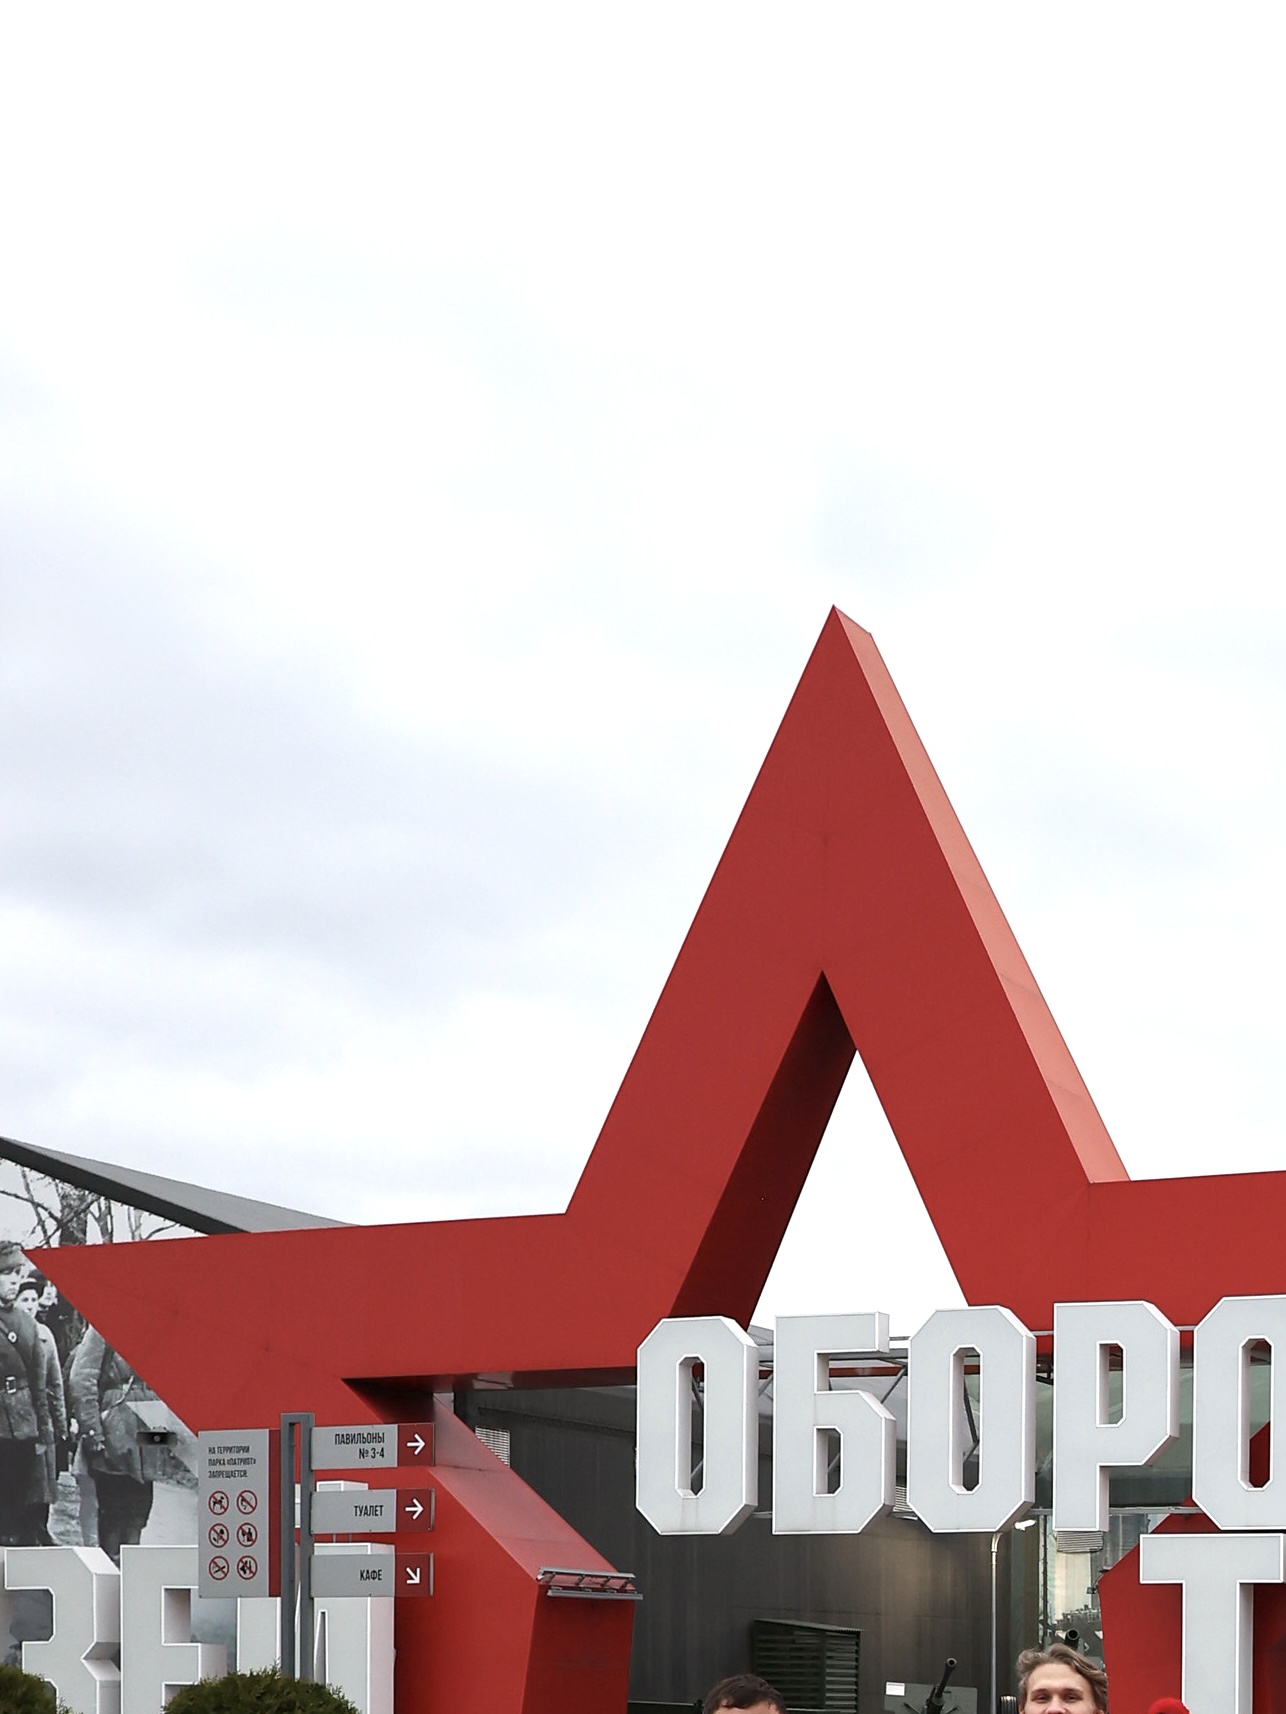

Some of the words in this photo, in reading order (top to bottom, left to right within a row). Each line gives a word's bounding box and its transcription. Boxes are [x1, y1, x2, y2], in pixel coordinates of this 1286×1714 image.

[334, 1432, 385, 1445] ПАВИЛЬОНЫ
[358, 1448, 369, 1459] №
[370, 1448, 385, 1459] 3-4
[353, 1504, 384, 1517] ТУАЛЕТ
[360, 1569, 383, 1581] КАФЕ
